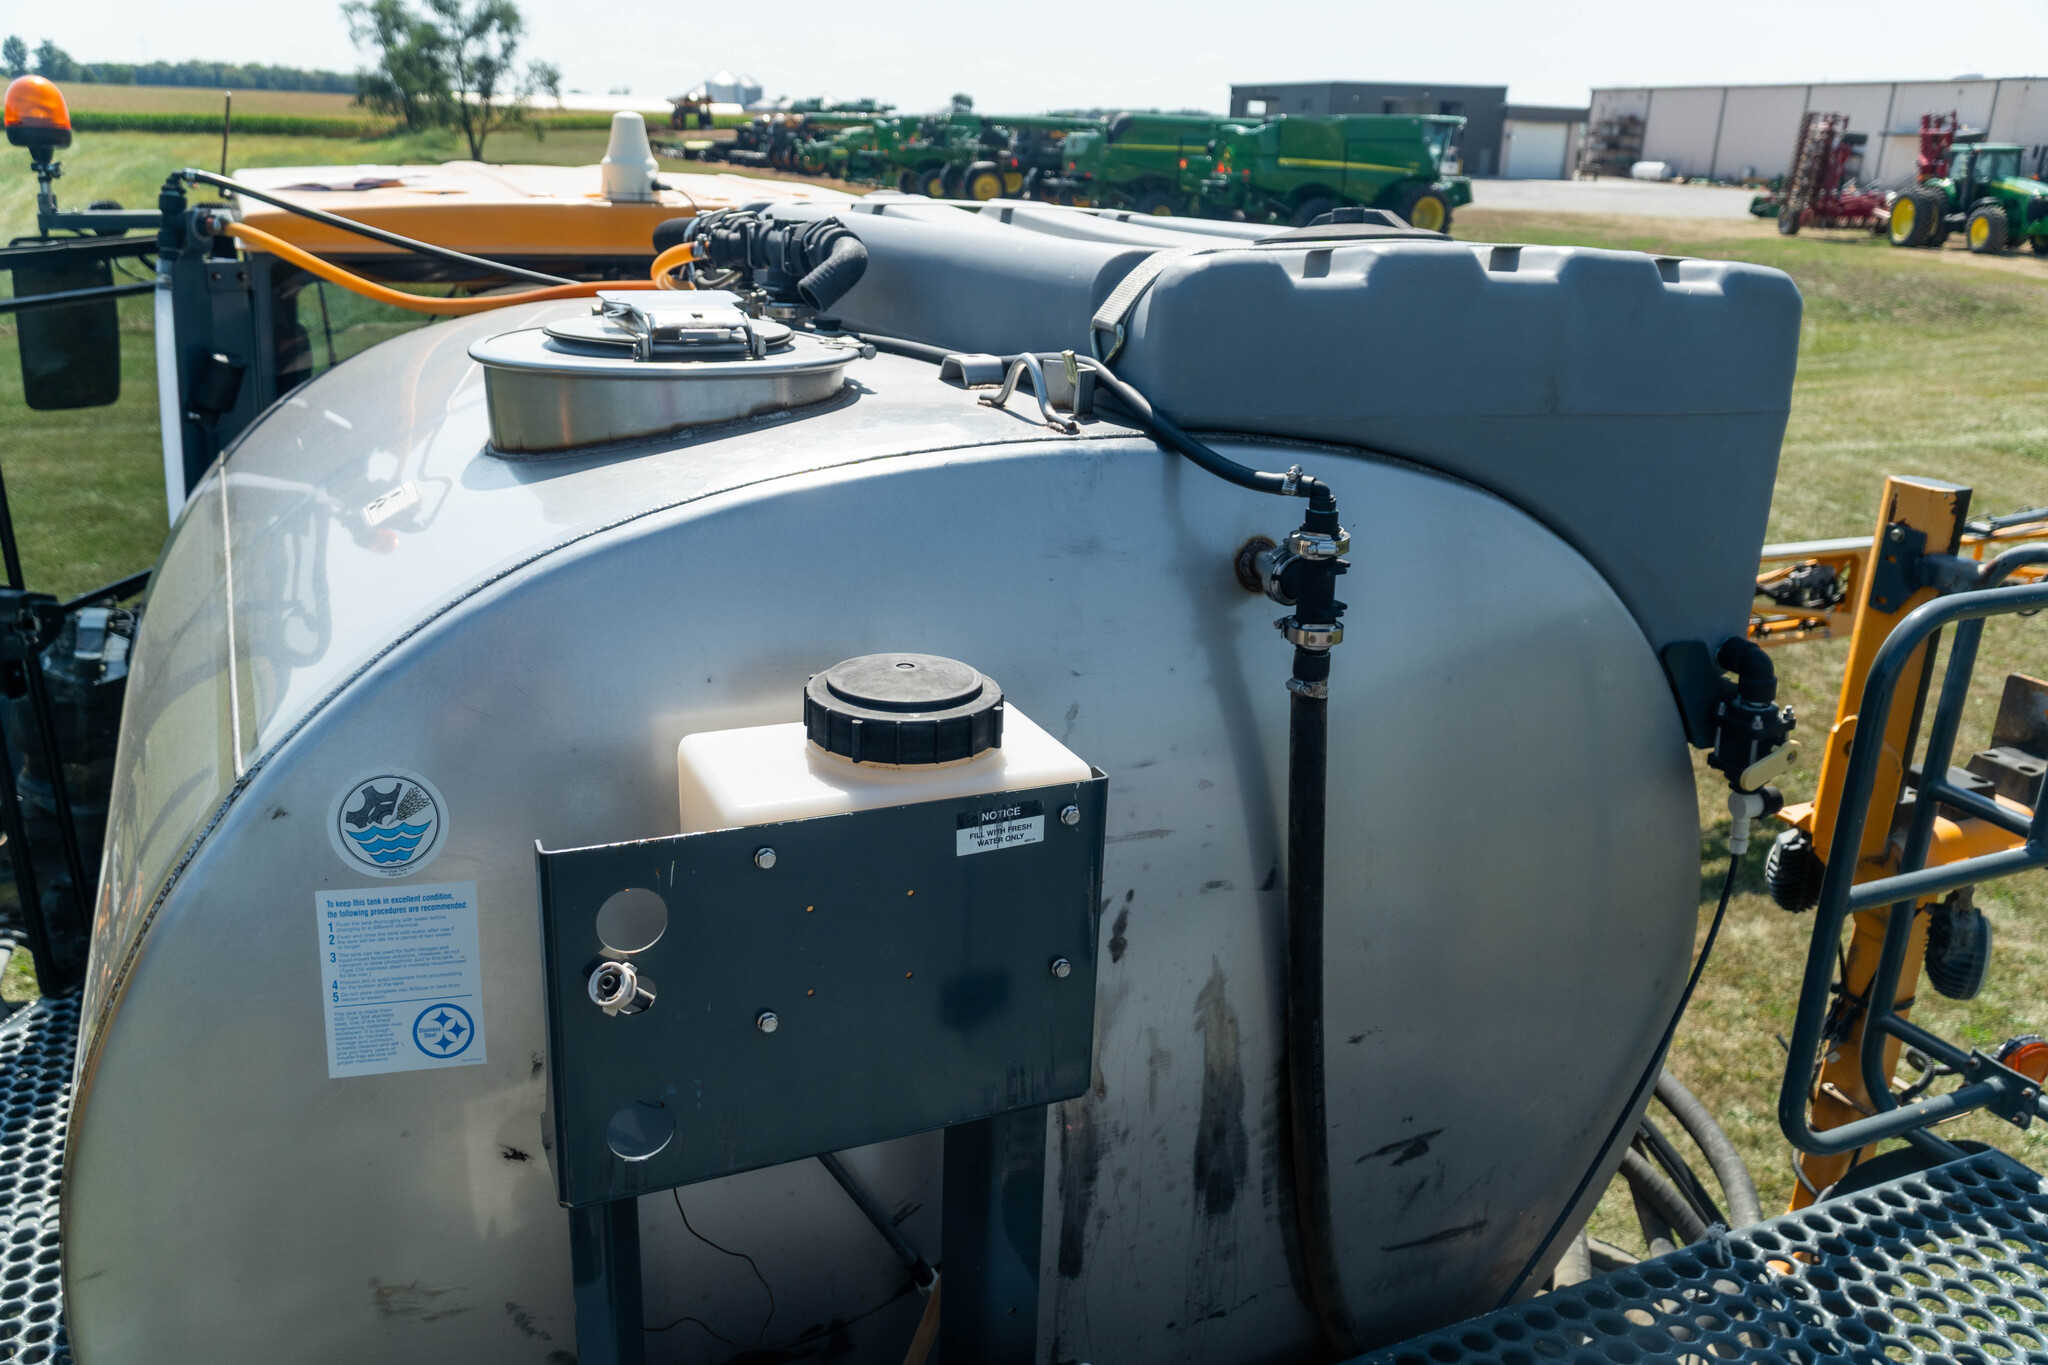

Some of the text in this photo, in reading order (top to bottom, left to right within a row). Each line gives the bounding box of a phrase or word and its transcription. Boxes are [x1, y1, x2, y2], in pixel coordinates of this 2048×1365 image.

[982, 807, 1020, 821] NOTICE
[987, 828, 1006, 836] WITH
[1008, 823, 1032, 832] FRESH
[978, 836, 1004, 846] WATER
[1005, 833, 1024, 842] ONLY
[326, 891, 454, 908] To keep this tank in excellent condition,
[327, 901, 467, 919] the following procedures are recommended:
[327, 922, 332, 932] 1
[328, 934, 334, 945] 2
[329, 952, 336, 963] 3
[331, 980, 338, 990] 4
[332, 991, 338, 1002] 5
